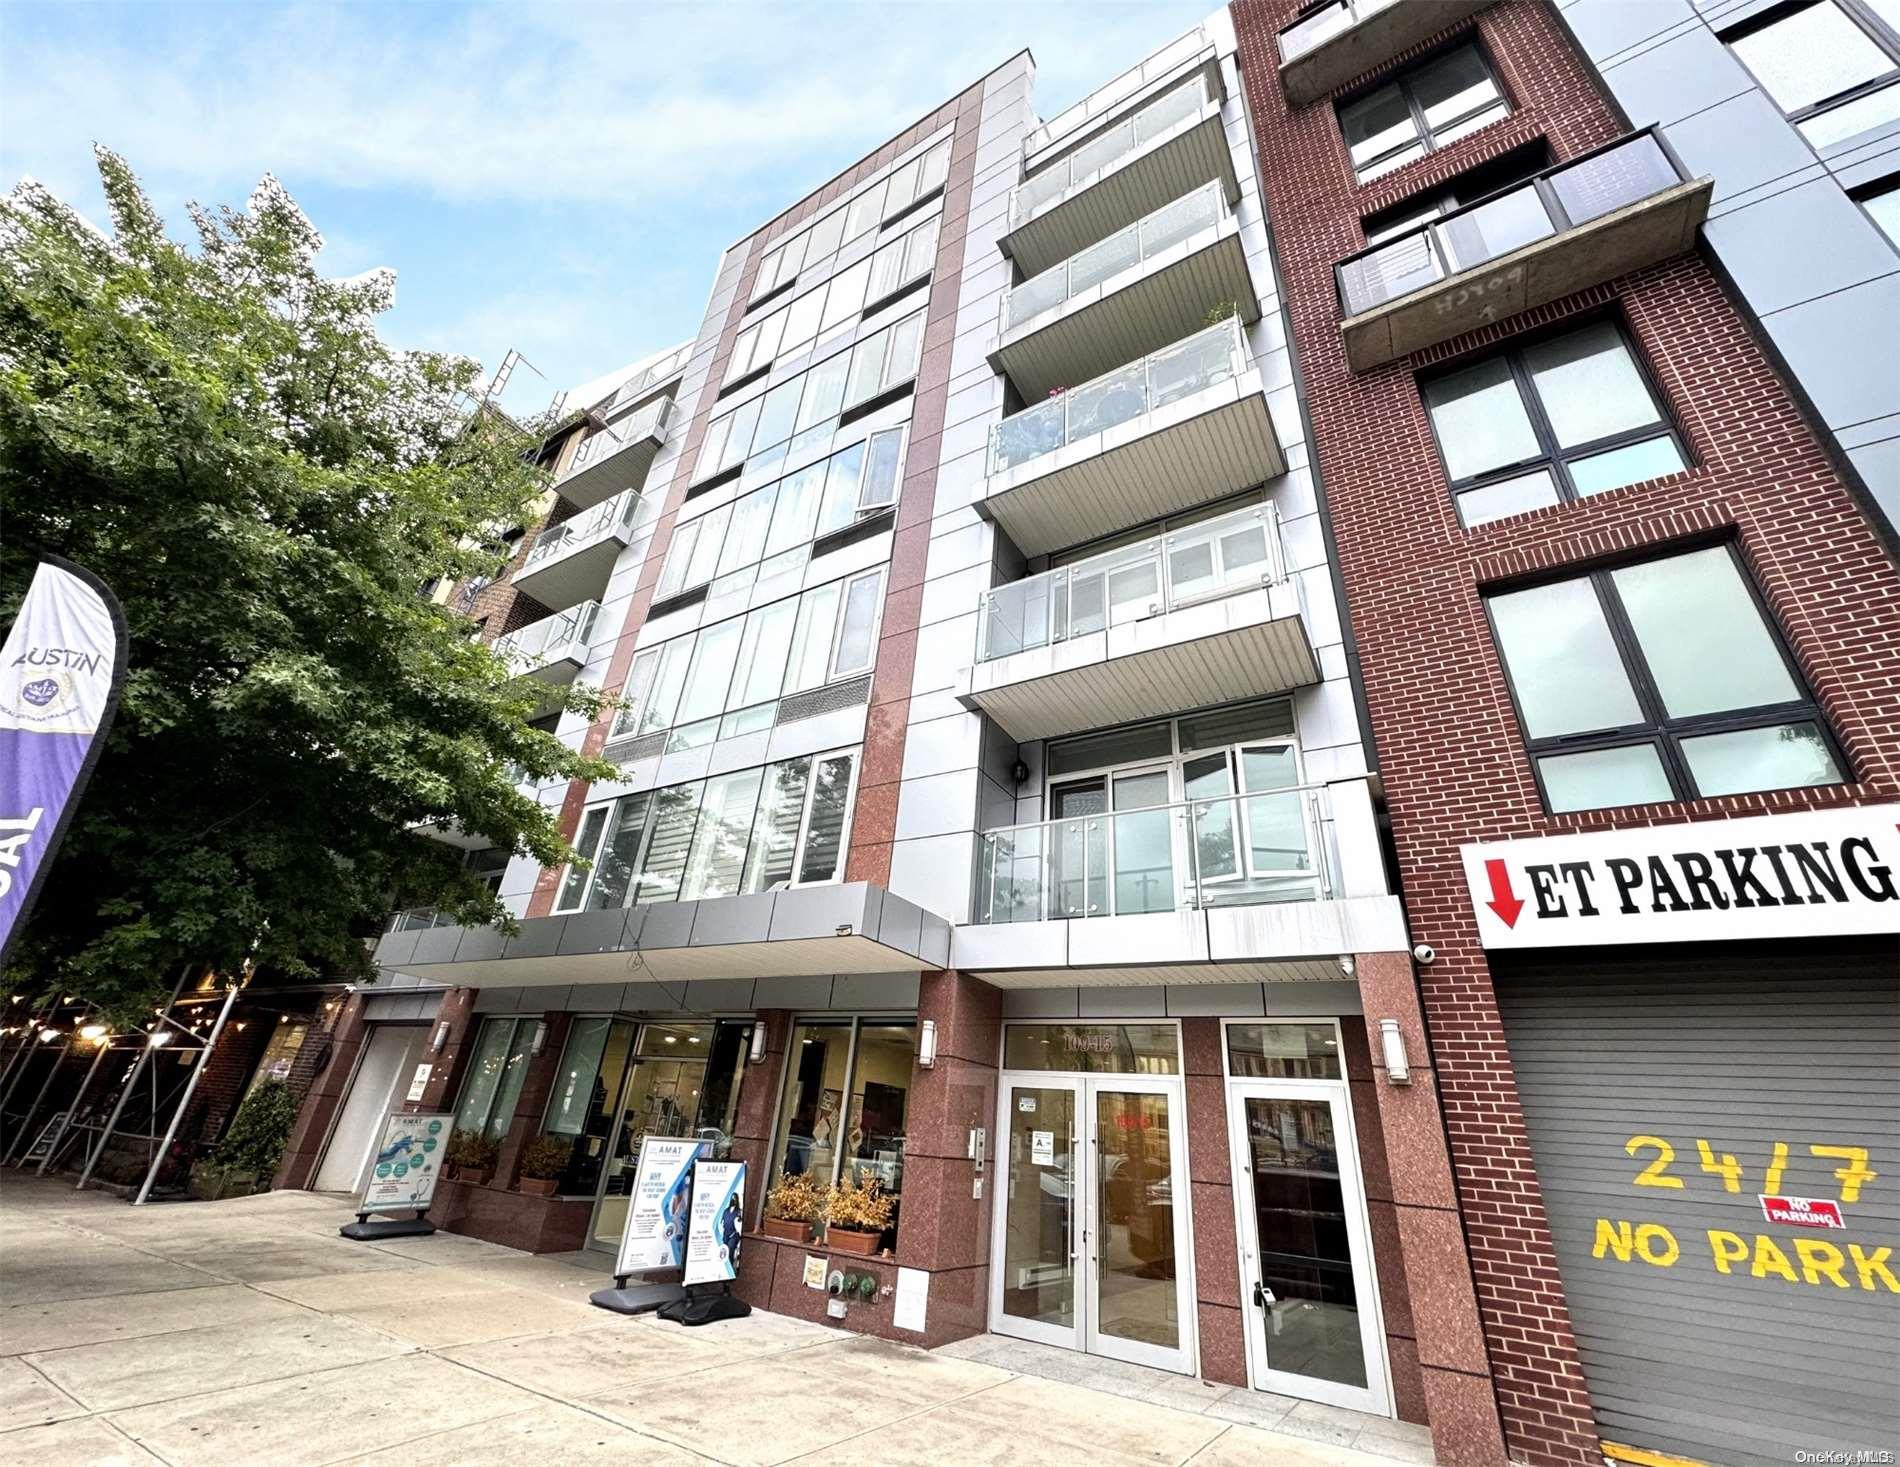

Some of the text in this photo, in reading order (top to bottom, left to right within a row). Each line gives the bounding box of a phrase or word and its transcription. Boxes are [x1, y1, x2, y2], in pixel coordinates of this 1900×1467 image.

[10, 647, 101, 676] AUSTIN
[0, 807, 44, 898] AL
[1524, 837, 1899, 919] ET PARKING
[659, 1146, 683, 1154] AMAT
[1625, 1135, 1878, 1202] 24/7
[1772, 1210, 1835, 1225] PARKING
[1789, 1199, 1810, 1212] NO
[1592, 1219, 1900, 1294] NO PARK
